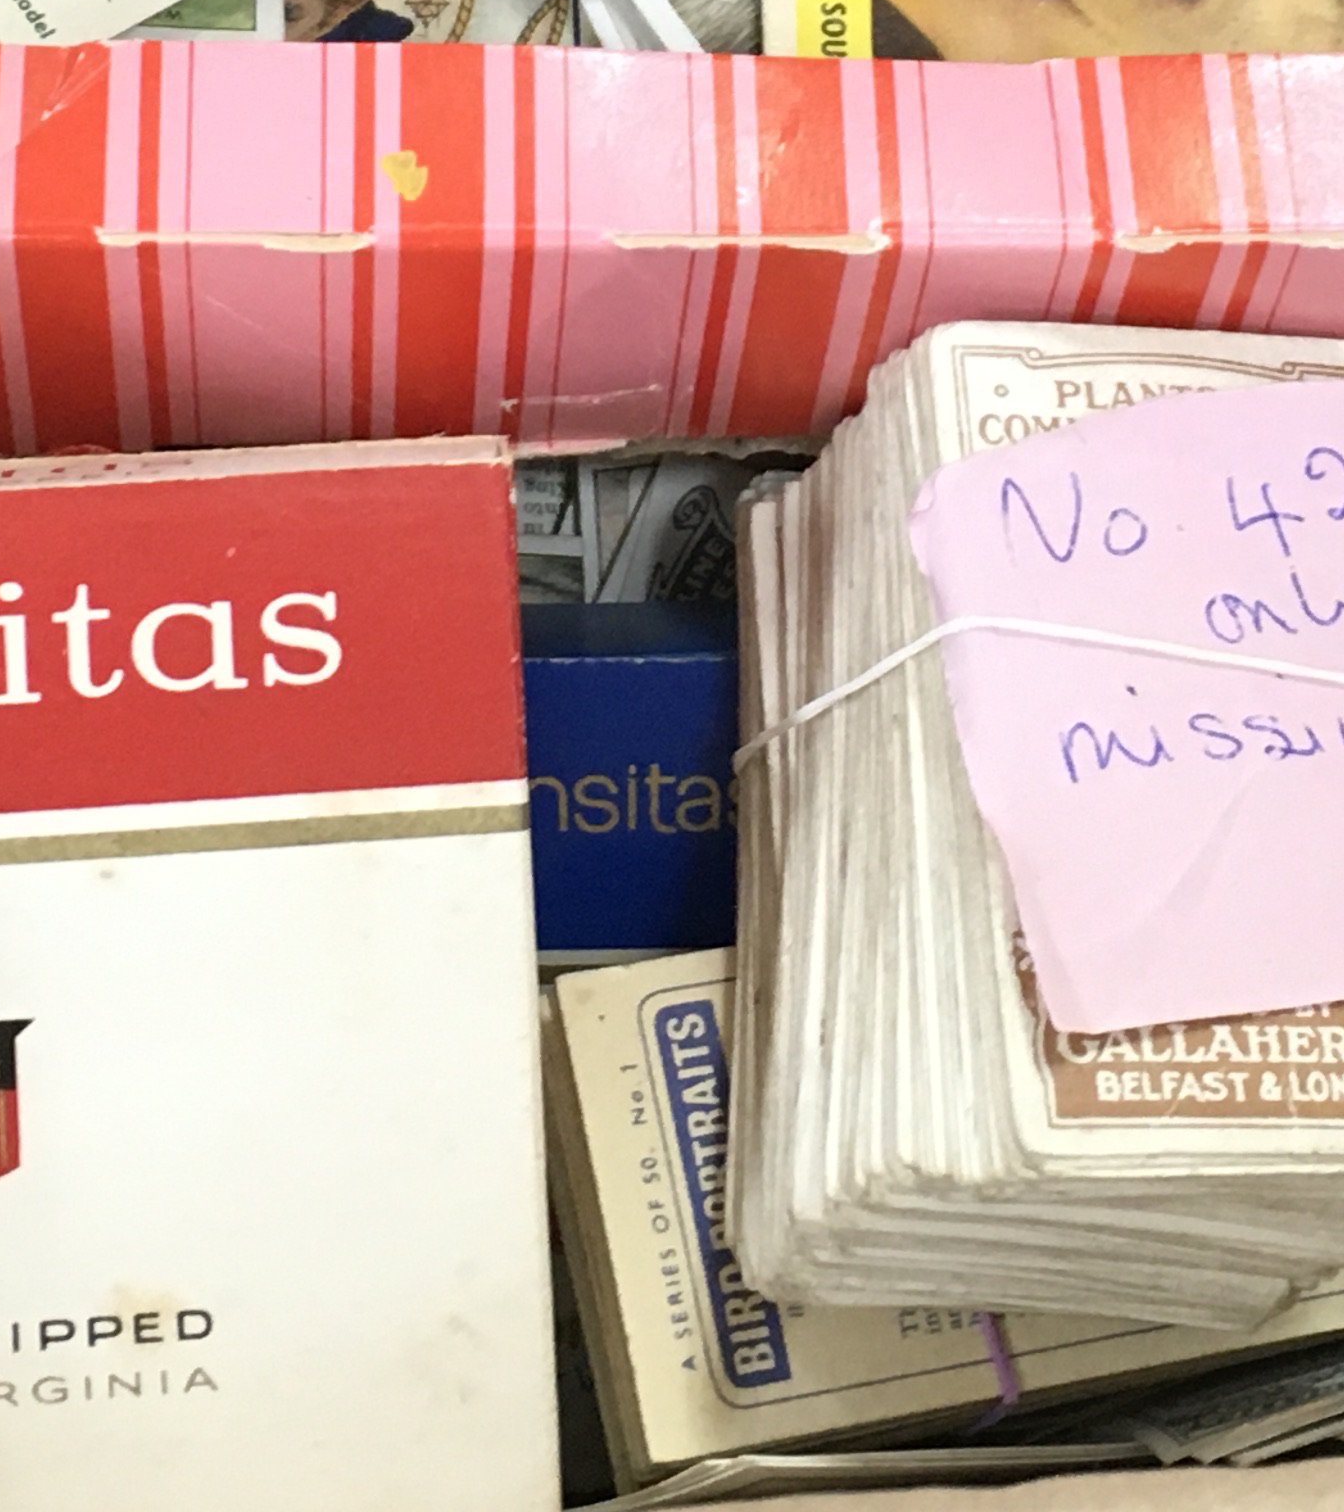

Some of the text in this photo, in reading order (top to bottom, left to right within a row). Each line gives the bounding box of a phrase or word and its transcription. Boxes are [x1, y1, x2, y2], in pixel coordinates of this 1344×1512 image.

[1054, 379, 1217, 410] PLAN
[1095, 1069, 1253, 1105] BELFAST
[1257, 1070, 1284, 1104] &
[647, 1198, 669, 1233] OF
[659, 1248, 691, 1338] SERIES
[681, 1355, 696, 1371] A
